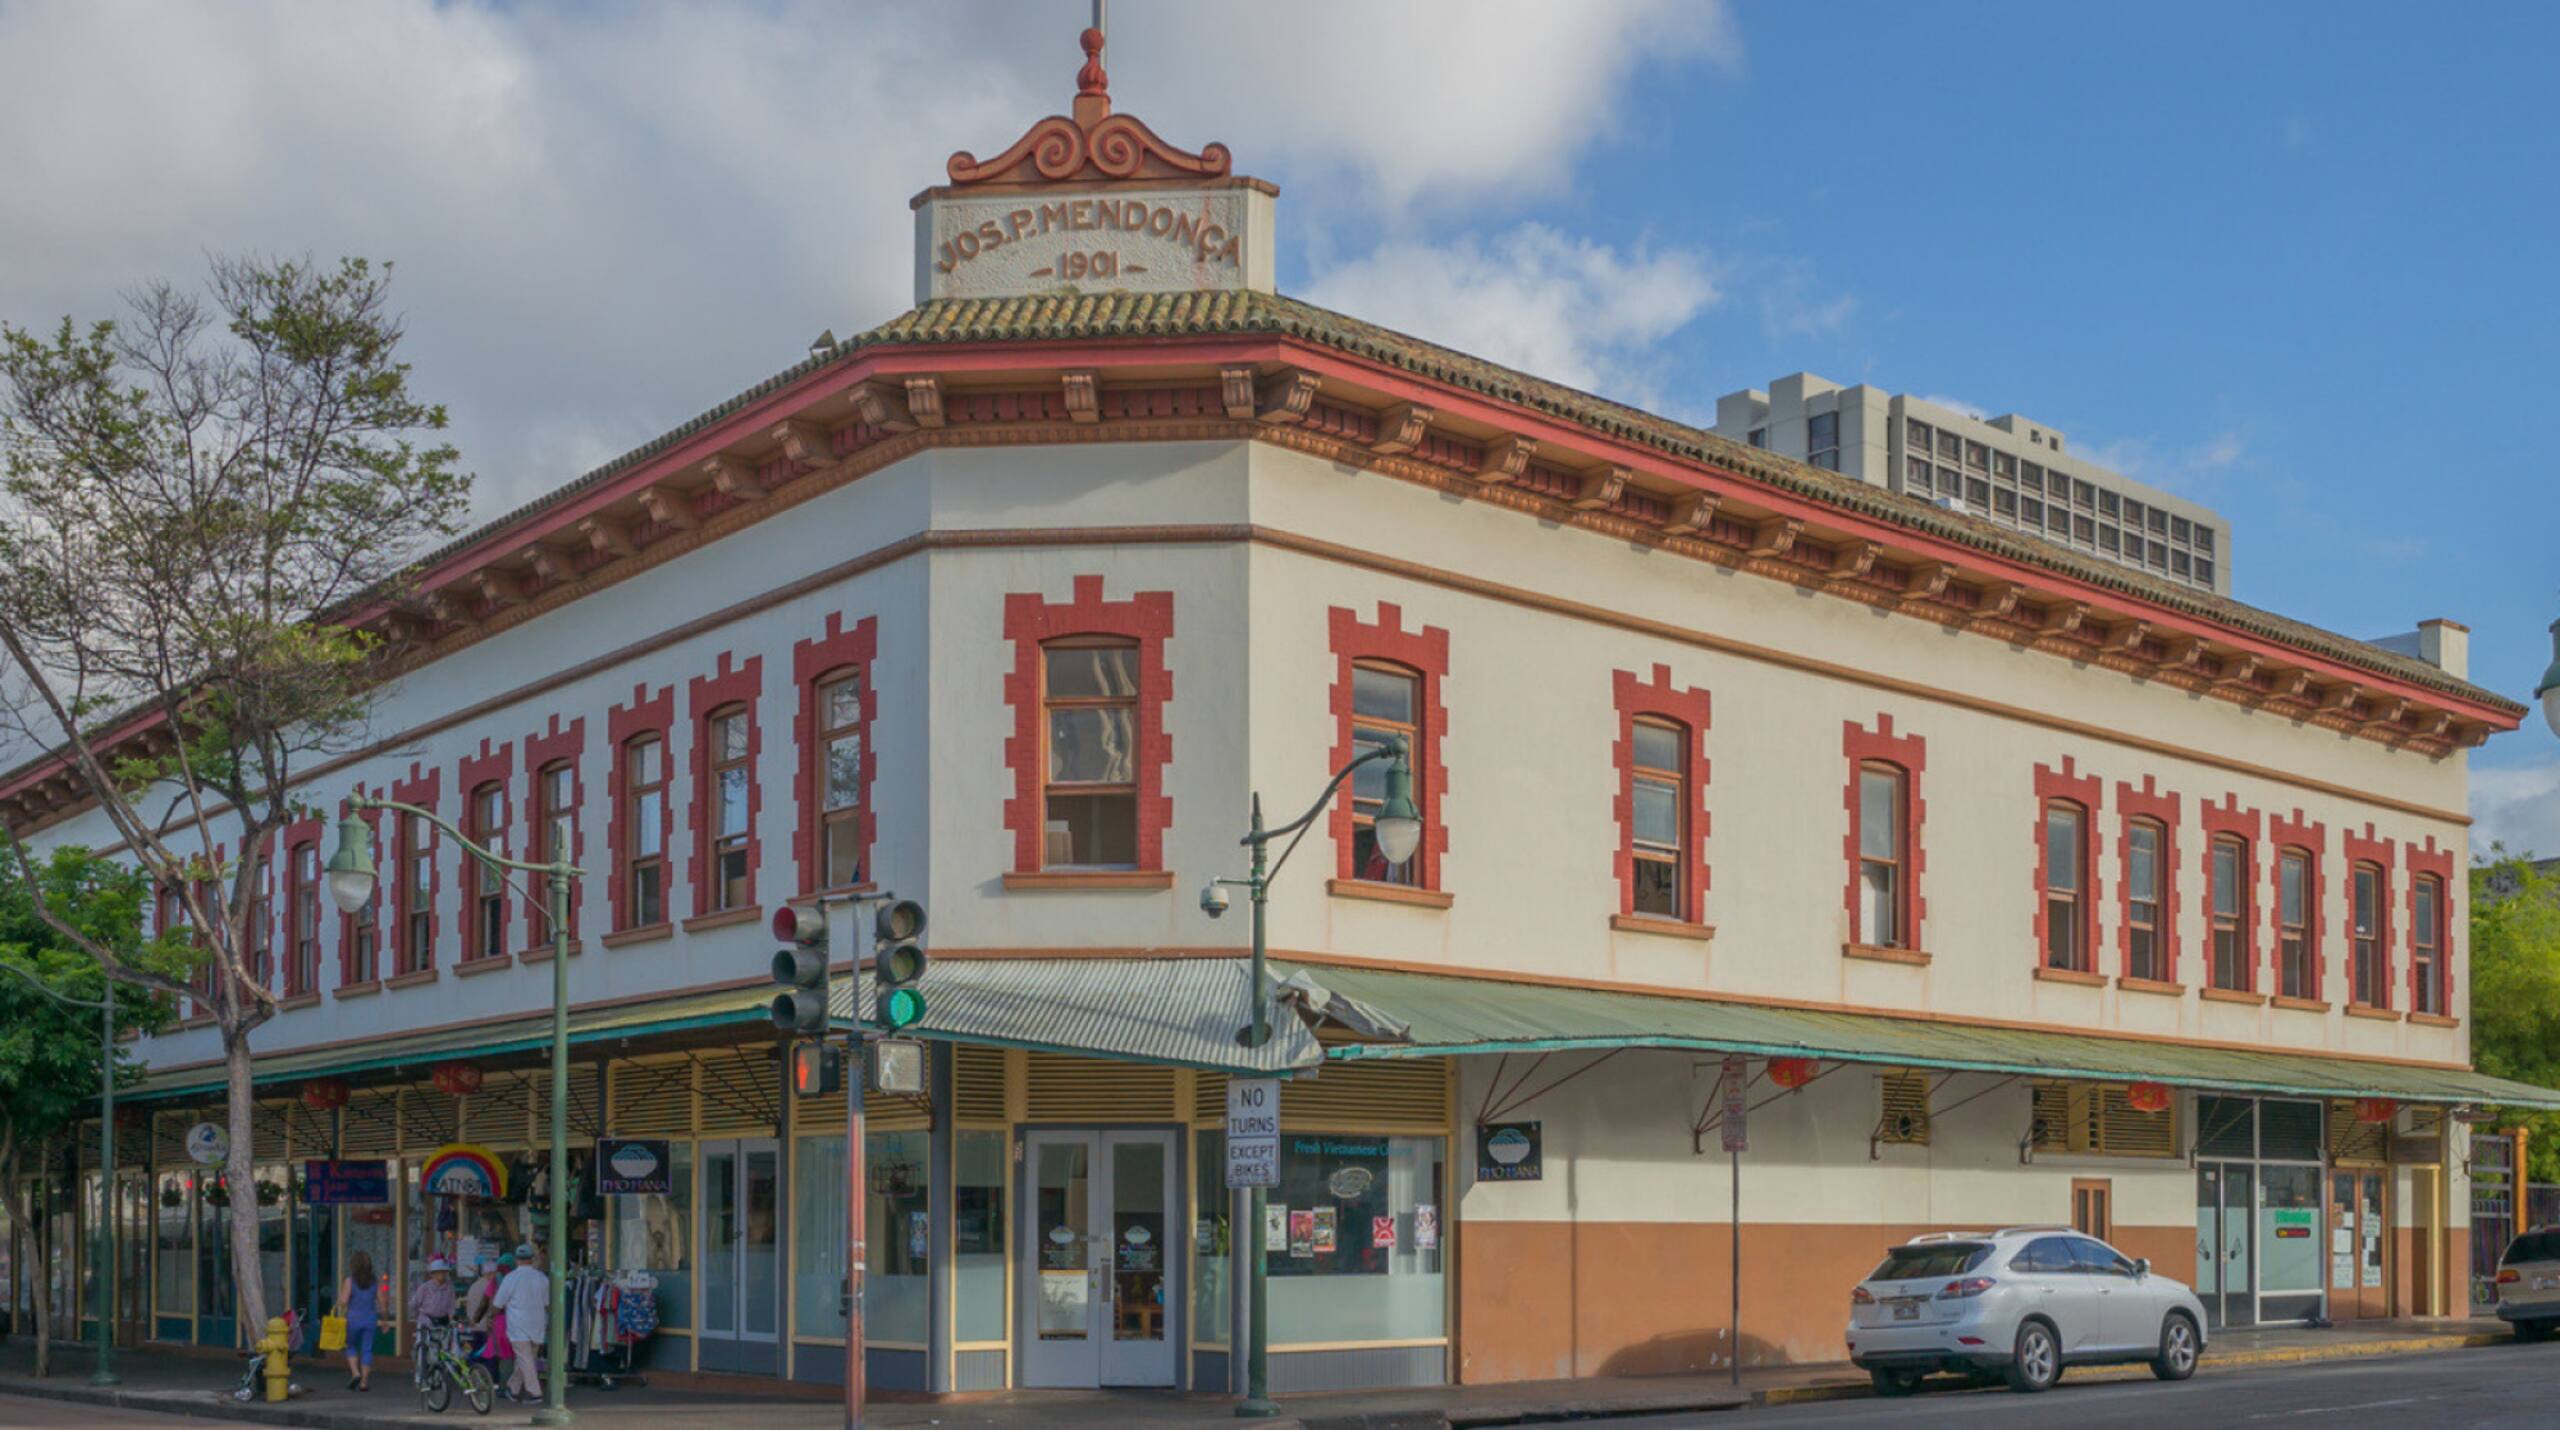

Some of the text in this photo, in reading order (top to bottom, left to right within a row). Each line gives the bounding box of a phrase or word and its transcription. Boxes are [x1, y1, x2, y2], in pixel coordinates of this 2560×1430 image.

[1240, 1087, 1264, 1107] NO
[1230, 1117, 1275, 1133] TURNS
[1230, 1145, 1274, 1160] EXCEPT
[1295, 1140, 1319, 1153] Fresh
[1323, 1142, 1378, 1156] Vietnamese
[1234, 1163, 1270, 1177] BIKES
